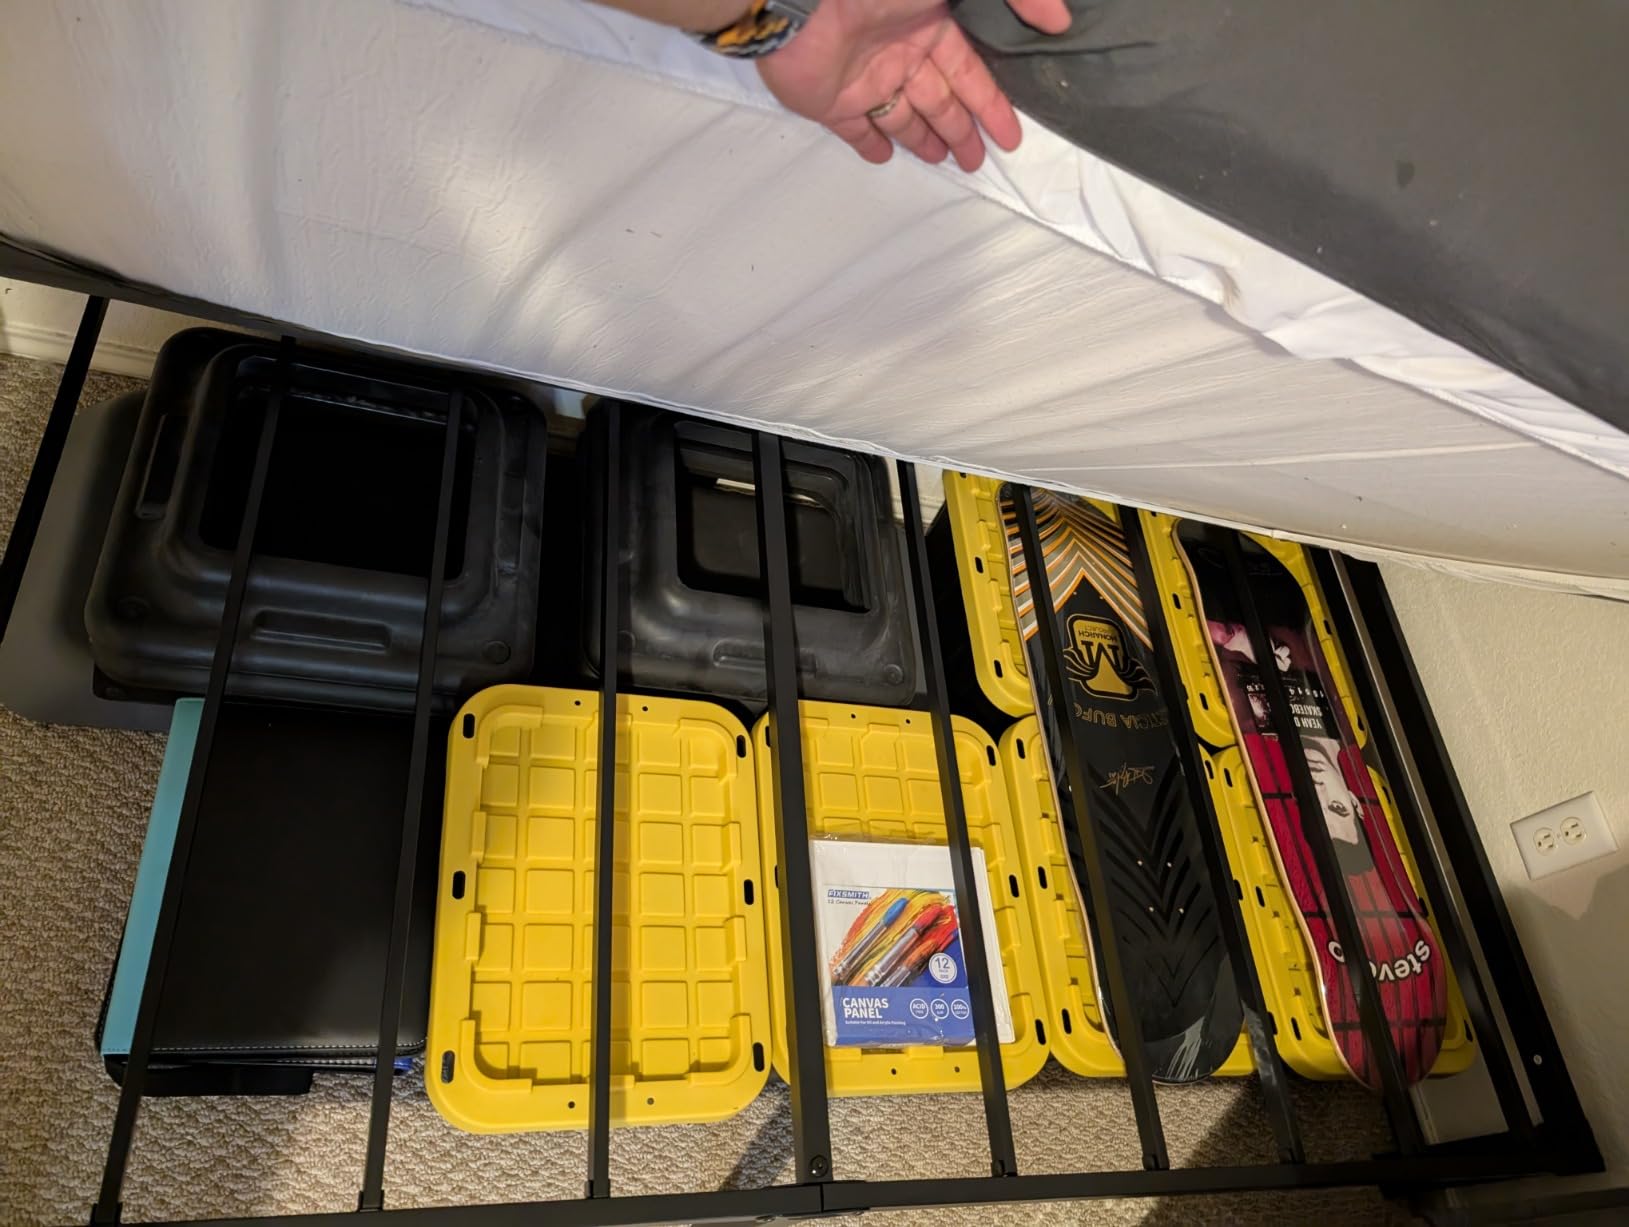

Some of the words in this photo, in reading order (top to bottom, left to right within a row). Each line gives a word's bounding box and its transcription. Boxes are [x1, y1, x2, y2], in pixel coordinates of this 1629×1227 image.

[1301, 716, 1322, 729] YEAH
[828, 889, 870, 899] FIXSMITH
[935, 957, 950, 969] 12
[842, 997, 889, 1009] CANVAS
[844, 1007, 883, 1019] PANEL
